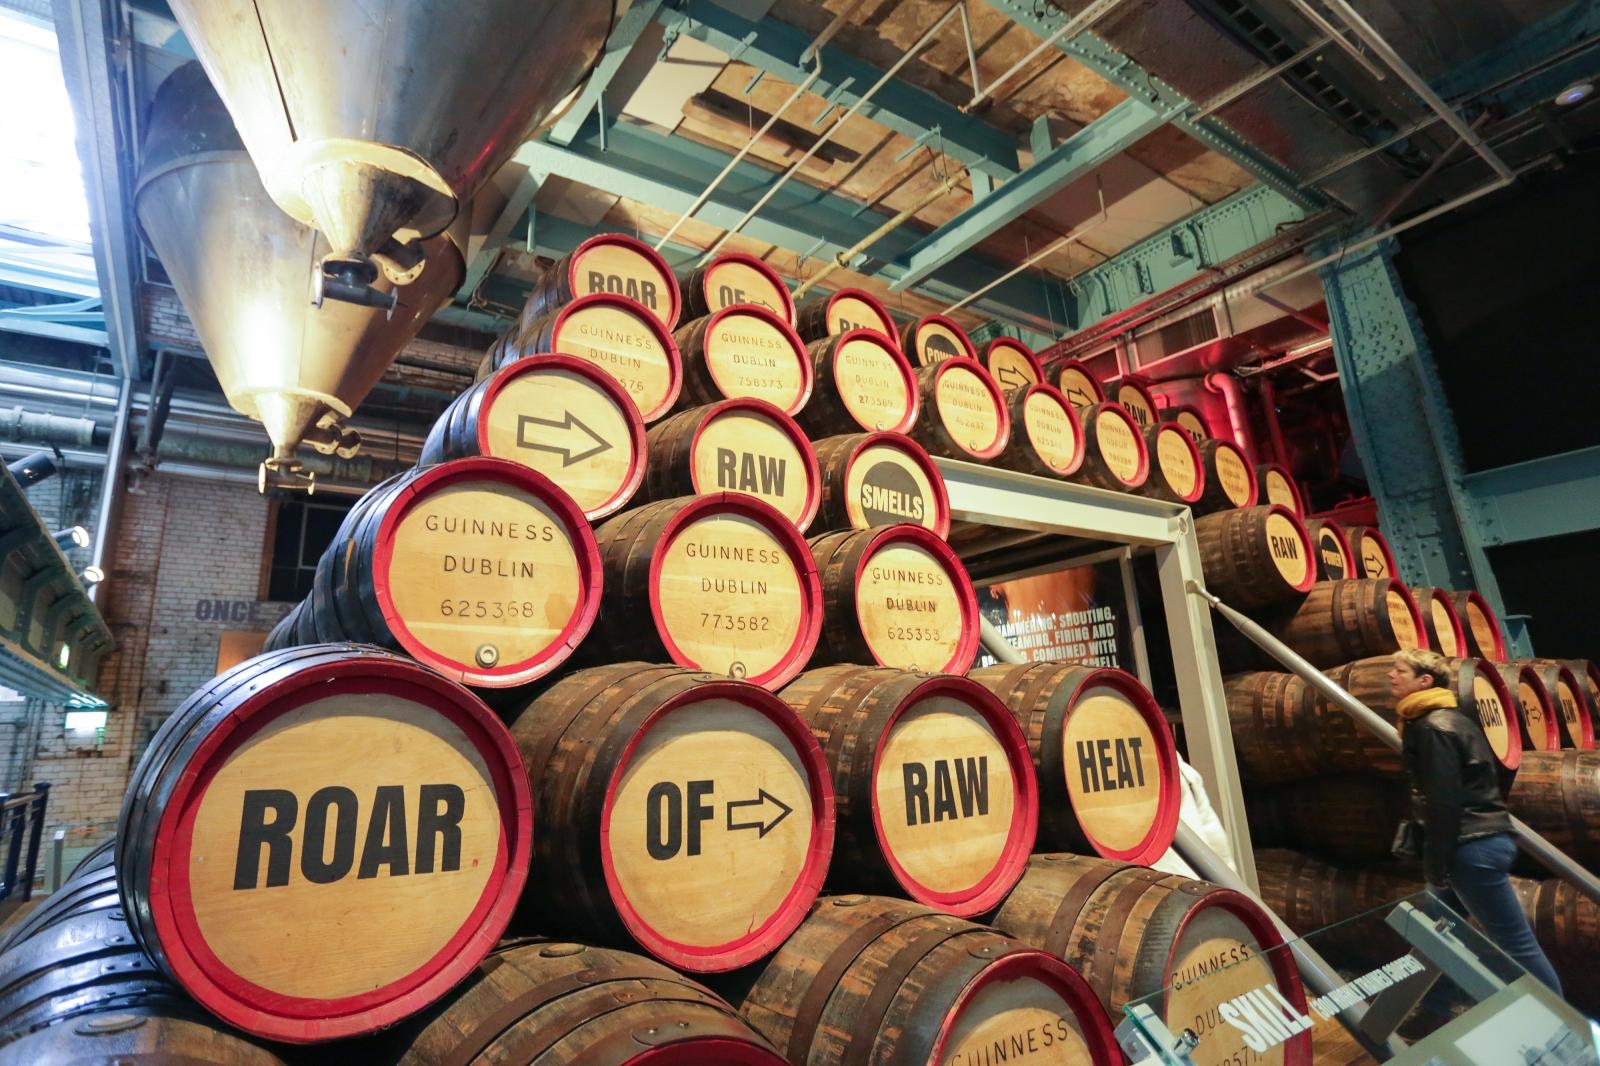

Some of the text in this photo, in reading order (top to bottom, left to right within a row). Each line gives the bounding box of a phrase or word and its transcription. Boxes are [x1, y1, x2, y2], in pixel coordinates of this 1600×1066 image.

[719, 284, 746, 308] OF
[580, 324, 652, 350] GUINNESS
[721, 332, 782, 349] GUINNESS
[590, 348, 641, 369] DUBLIN
[733, 353, 776, 368] DUBLIN
[845, 354, 894, 372] GUINNESS
[855, 374, 889, 389] DUBLIN
[943, 379, 986, 398] GUINNESS
[717, 447, 786, 497] RAW
[861, 484, 923, 520] SMELLS
[425, 514, 554, 542] GUINNESS
[686, 542, 780, 565] GUINNESS
[1270, 535, 1298, 560] RAW
[443, 555, 534, 578] DUBLIN
[872, 567, 943, 586] GUINNESS
[702, 577, 768, 595] DUBLIN
[440, 599, 534, 619] 625368
[886, 597, 937, 612] DUBLIN
[700, 612, 769, 631] 773582
[1055, 626, 1090, 644] FIRING
[1092, 622, 1115, 639] AND
[1033, 643, 1086, 662] COMBINED
[1088, 638, 1117, 656] WITH
[1076, 736, 1146, 794] HEAT
[902, 756, 989, 827] RAW
[646, 779, 714, 861] OF
[233, 784, 465, 890] ROAR
[1170, 943, 1249, 990] GUINNESS
[1218, 983, 1316, 1053] SKILL
